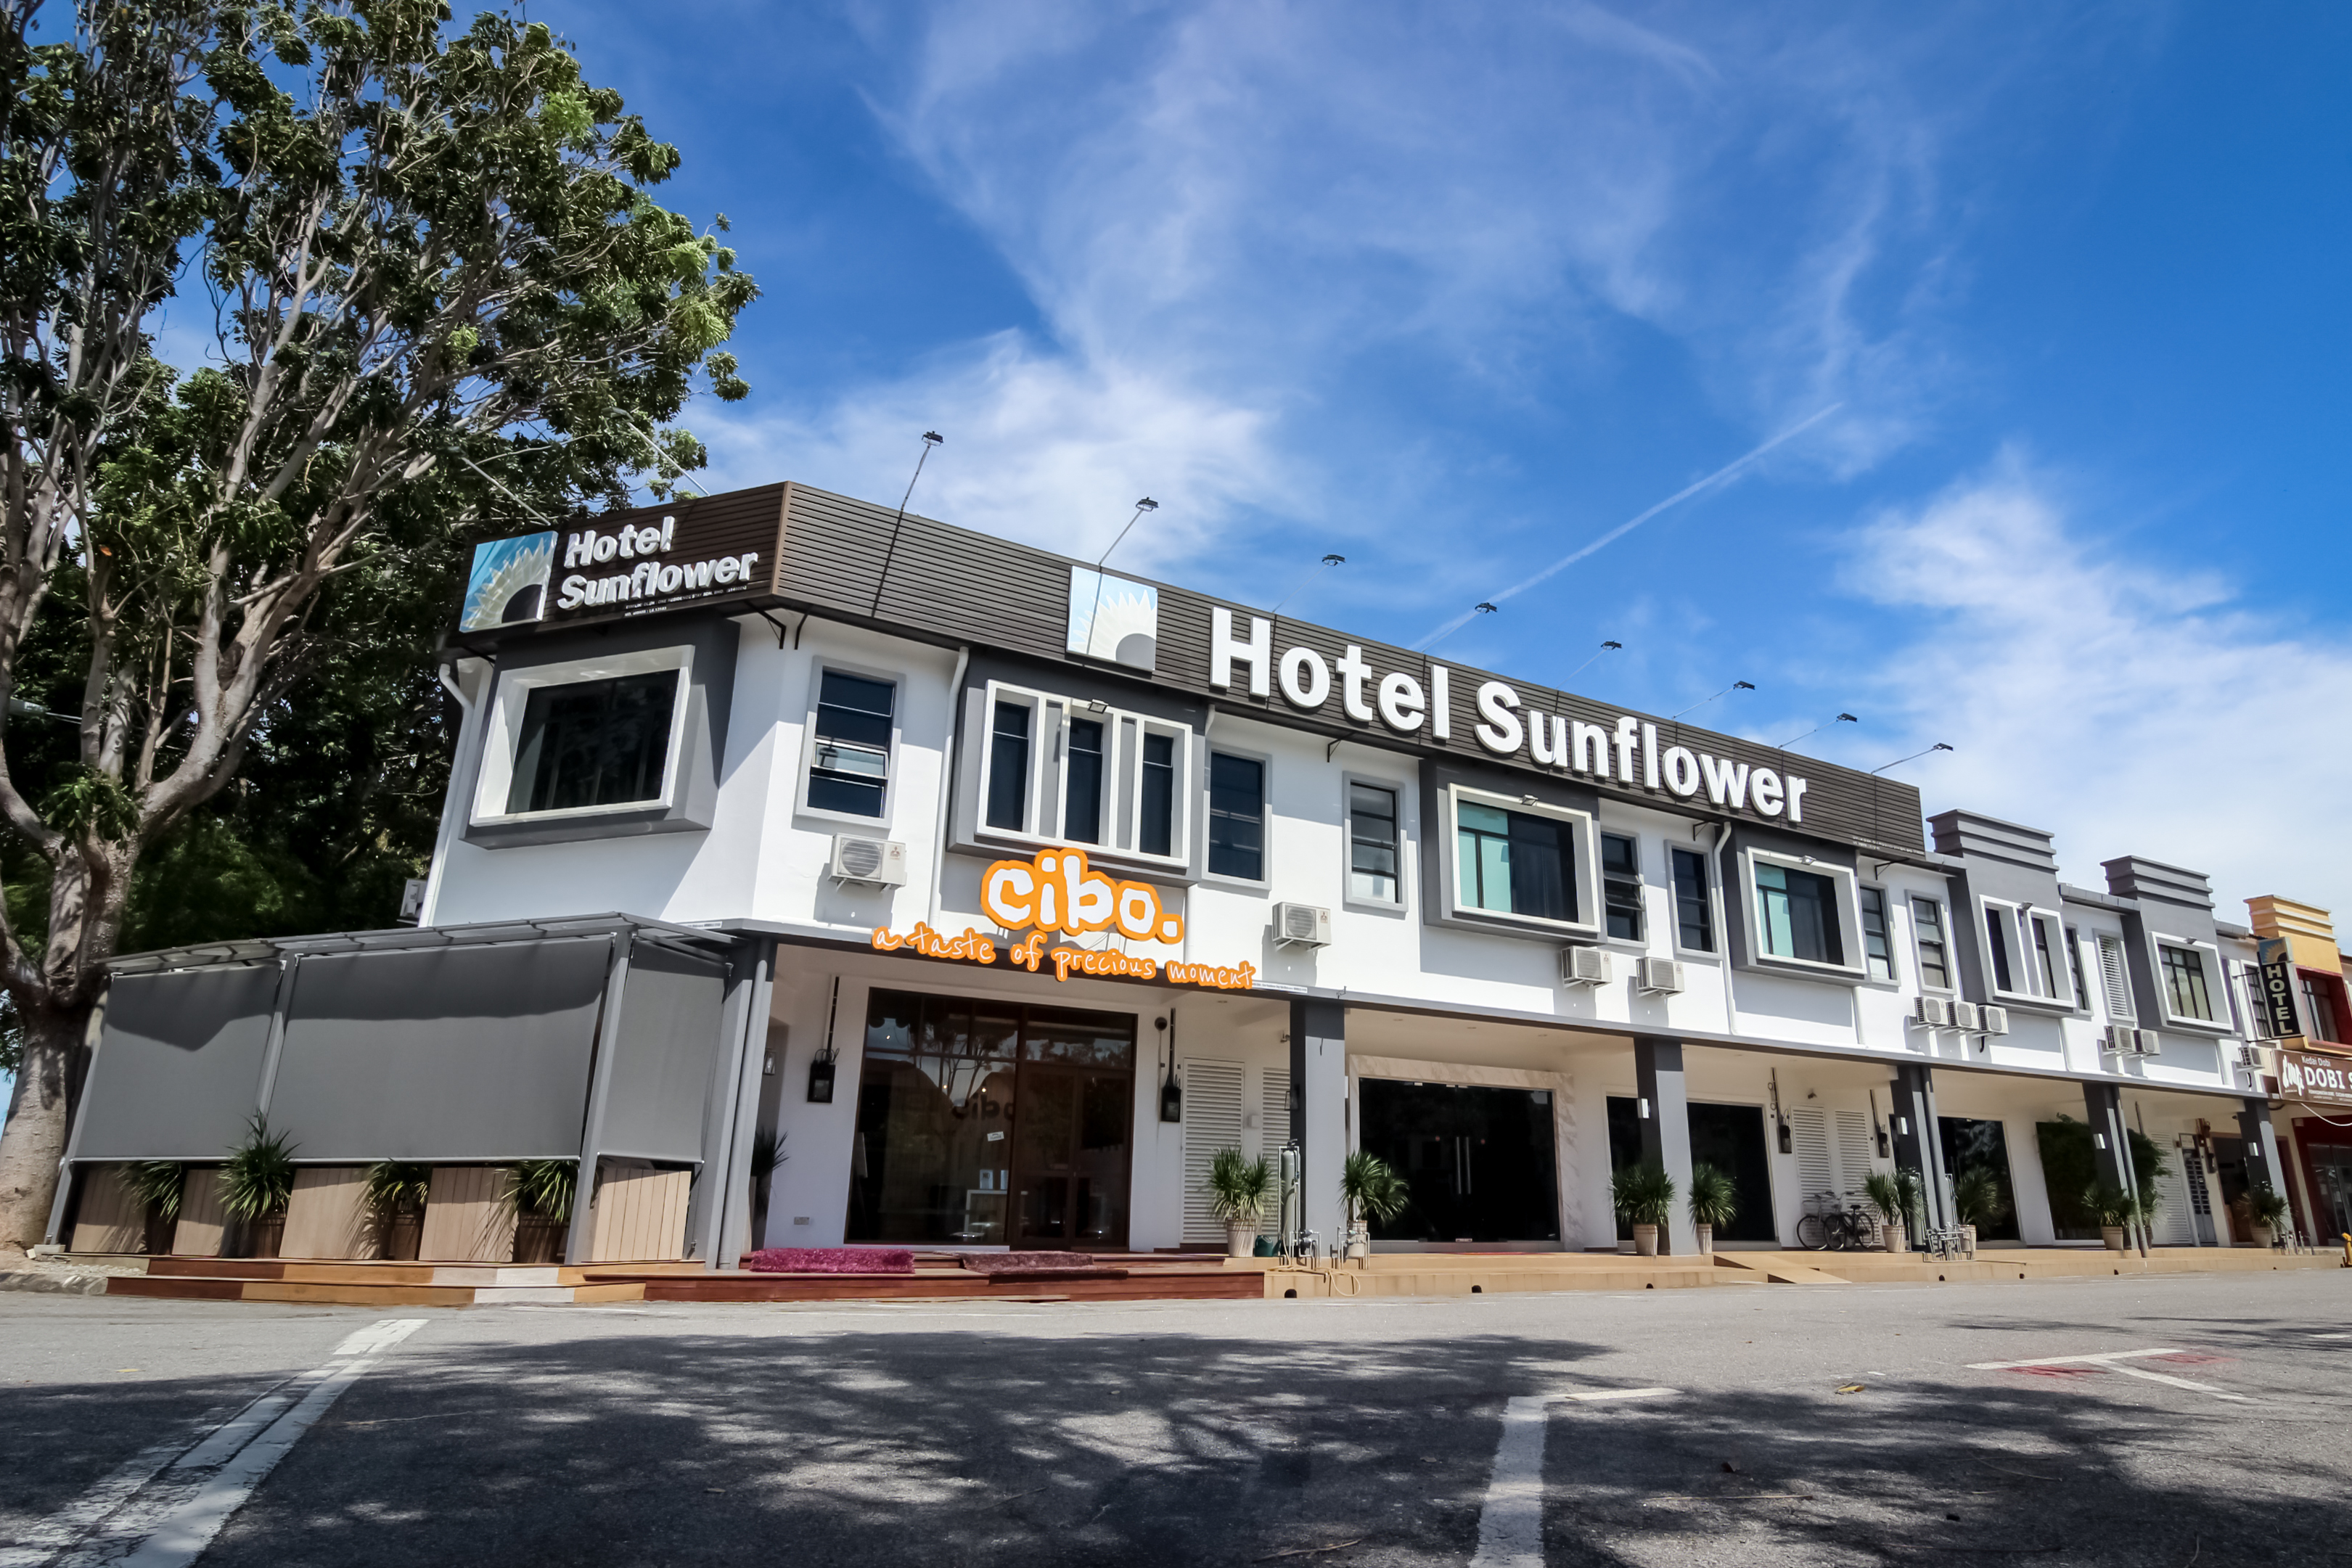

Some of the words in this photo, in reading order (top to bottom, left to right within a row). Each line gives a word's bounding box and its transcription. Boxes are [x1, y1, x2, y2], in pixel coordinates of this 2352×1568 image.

[564, 516, 675, 568] Hotel
[557, 552, 758, 610] Sunflower
[1210, 606, 1450, 740] Hotel
[1474, 681, 1807, 822] Sunflower
[876, 930, 899, 947] a
[909, 924, 992, 961] taste
[1014, 934, 1044, 968] of
[1054, 951, 1154, 978] precious
[1169, 963, 1253, 987] moment
[2266, 964, 2293, 1035] HOTEL
[2300, 1055, 2317, 1065] Kedai
[2317, 1057, 2331, 1067] Dobi
[2303, 1066, 2345, 1090] DOBI
